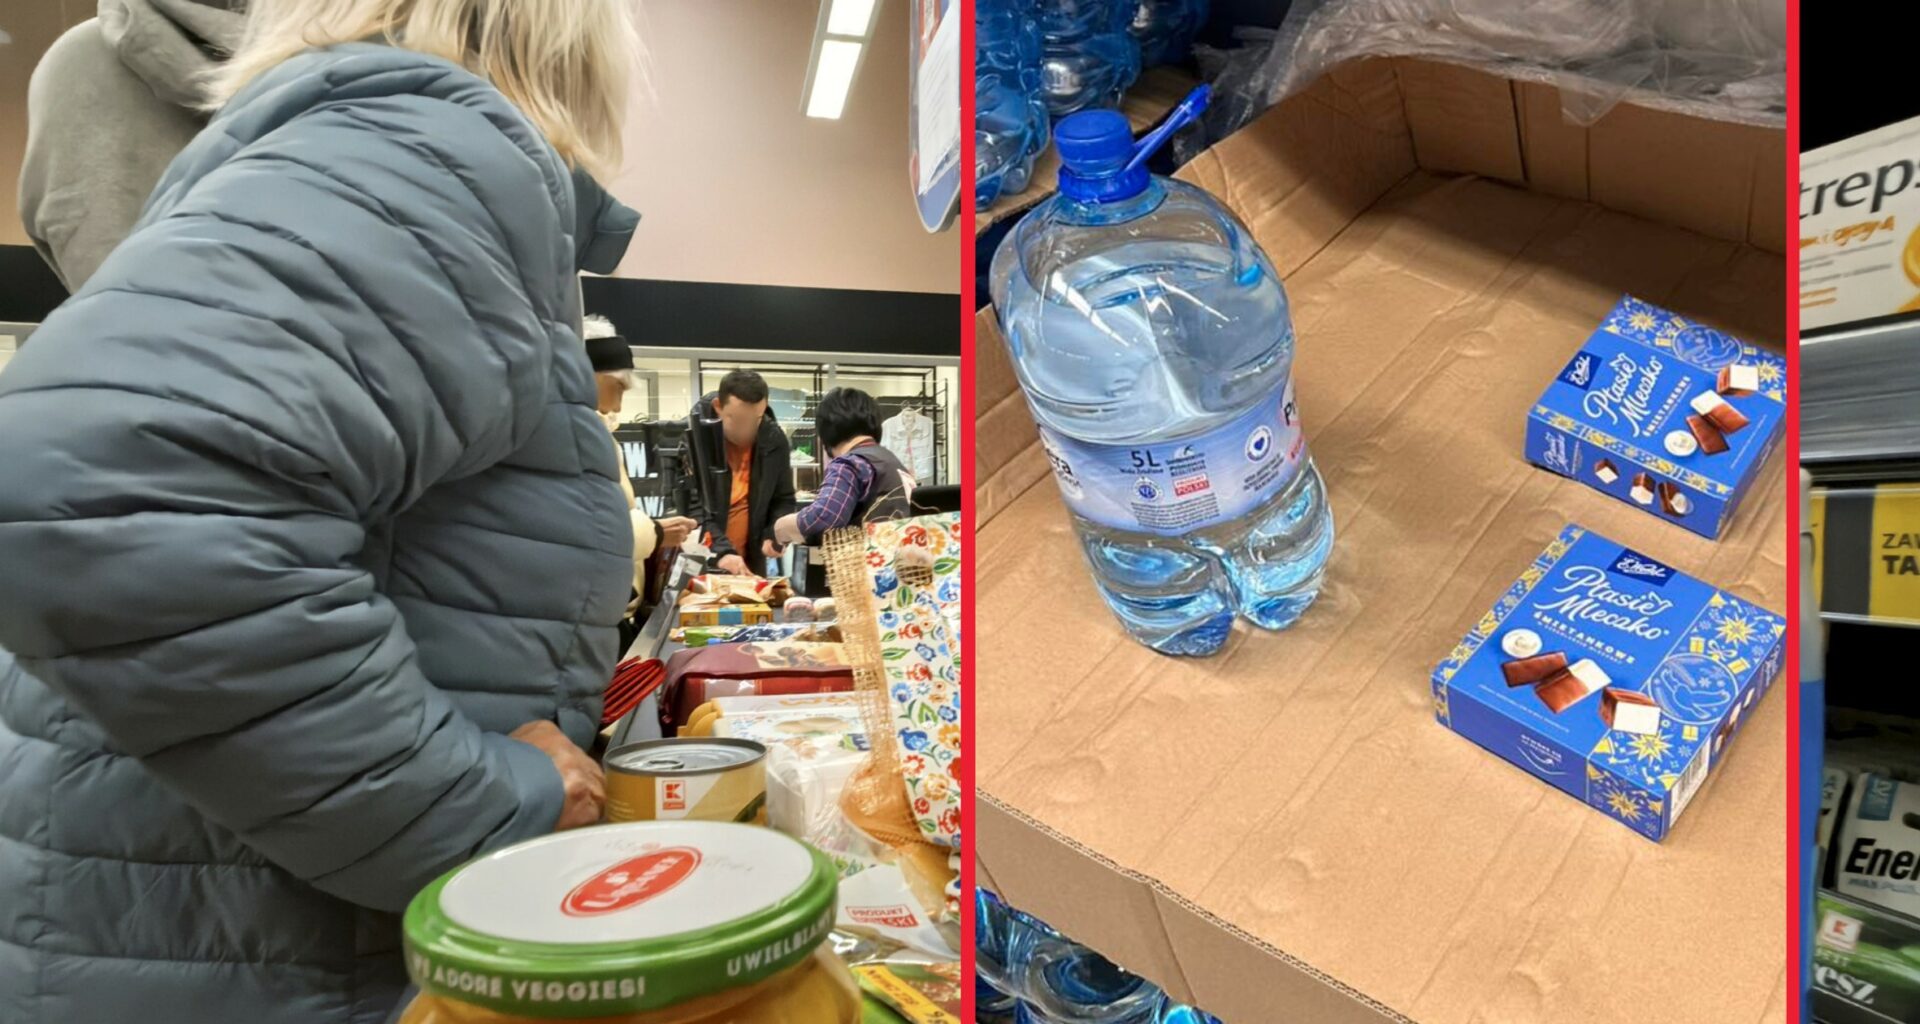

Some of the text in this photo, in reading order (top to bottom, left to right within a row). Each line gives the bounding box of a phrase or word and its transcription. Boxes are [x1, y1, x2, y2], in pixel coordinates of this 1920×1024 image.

[1553, 564, 1674, 616] Ptasie
[432, 966, 503, 999] ADORE
[511, 977, 647, 1003] VEGGIES!
